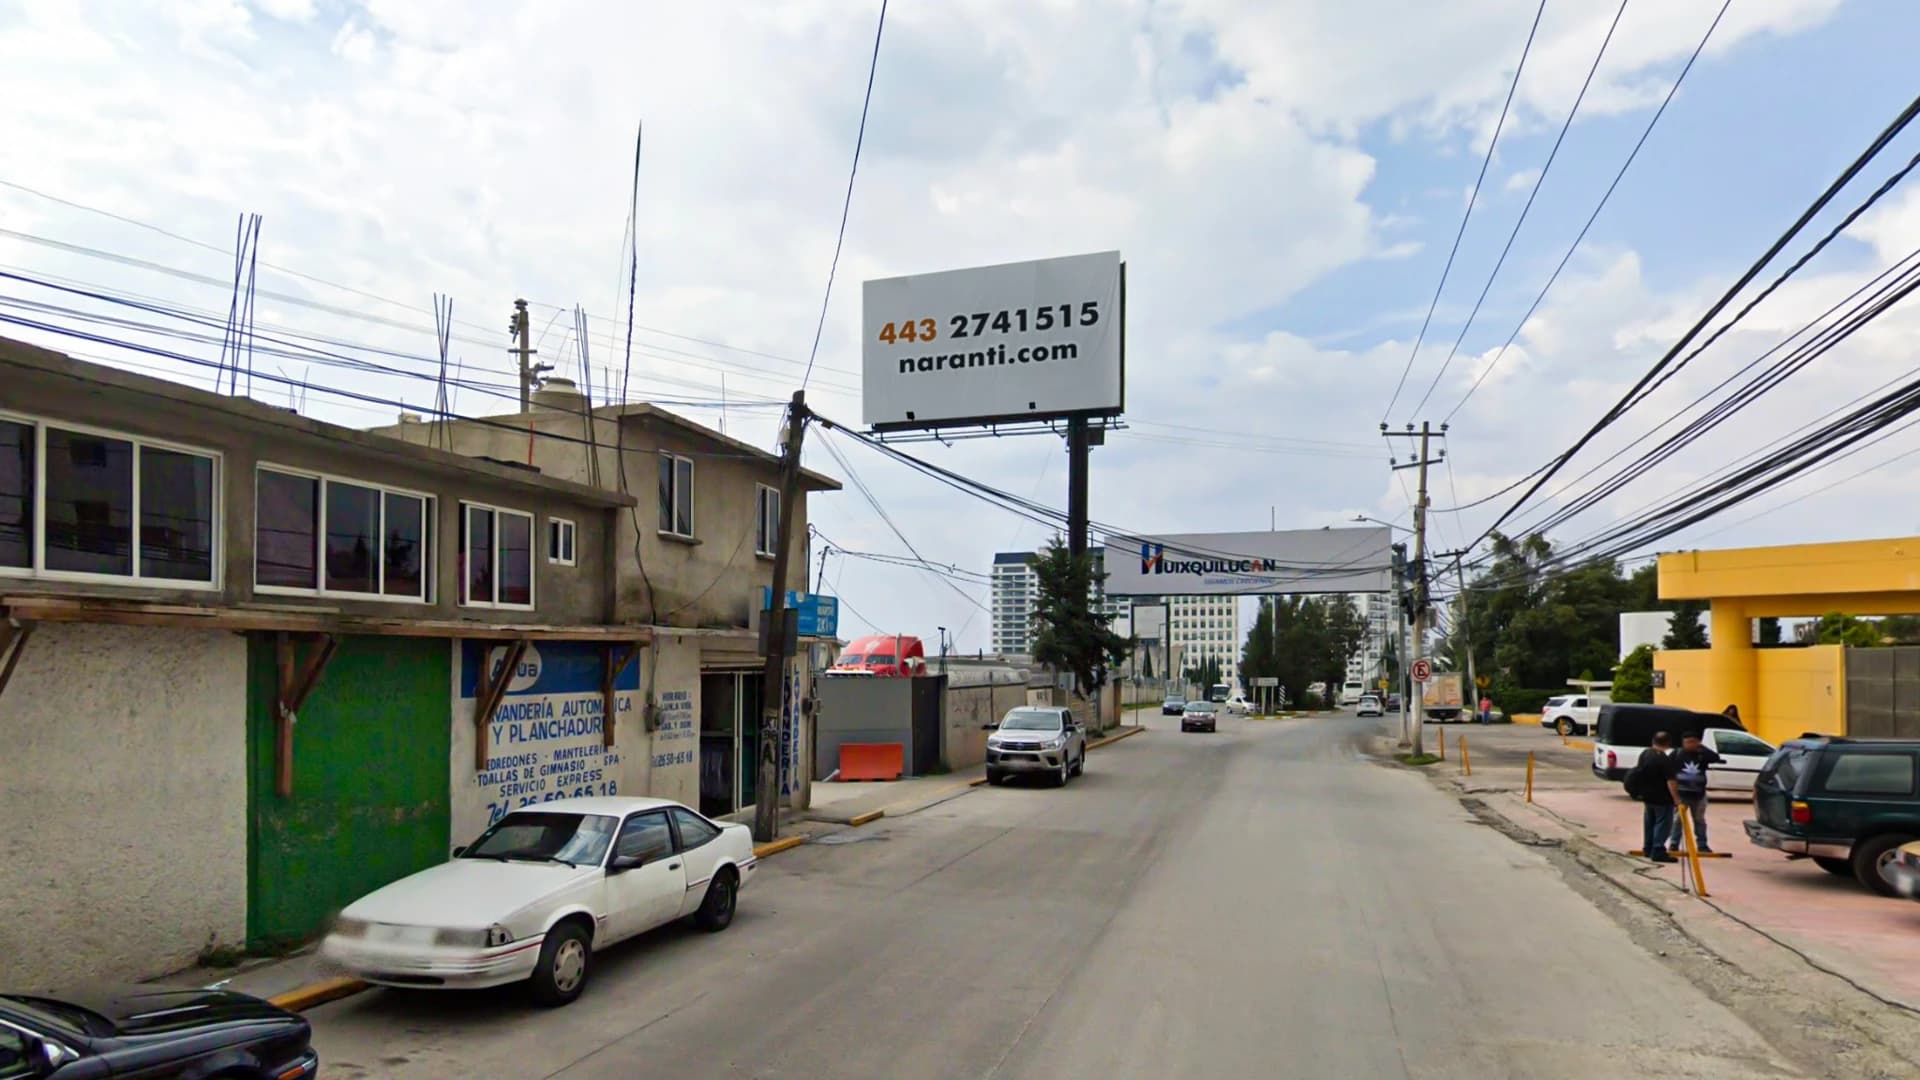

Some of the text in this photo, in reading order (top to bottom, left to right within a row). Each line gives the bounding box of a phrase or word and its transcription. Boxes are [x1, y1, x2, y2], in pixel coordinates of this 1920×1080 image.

[879, 301, 1099, 345] 443 2741515
[899, 343, 1078, 373] naranti.com
[1141, 544, 1276, 576] HUIXQUILUCAN
[492, 725, 503, 745] Y
[478, 755, 619, 787] TOALLAS DE GIMNASIO SPA
[486, 753, 537, 771] EDREDONES
[500, 769, 602, 797] SERVICIO EXPRESS
[600, 781, 617, 796] 18
